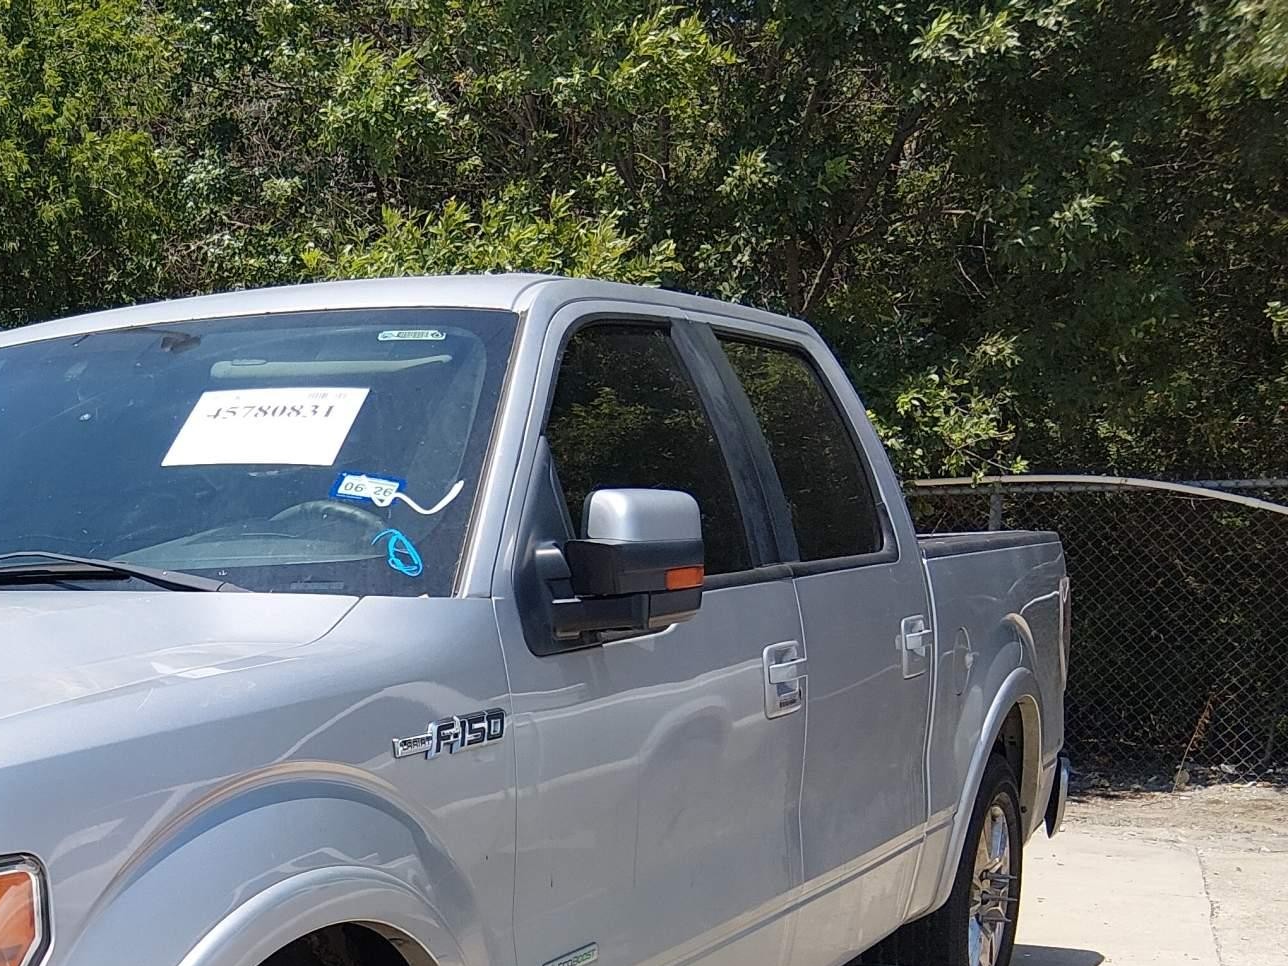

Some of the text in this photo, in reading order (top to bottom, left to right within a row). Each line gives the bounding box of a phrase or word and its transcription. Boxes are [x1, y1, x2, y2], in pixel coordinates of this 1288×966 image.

[206, 404, 336, 419] 45780831
[344, 482, 393, 497] 06 26
[424, 708, 506, 760] F-150
